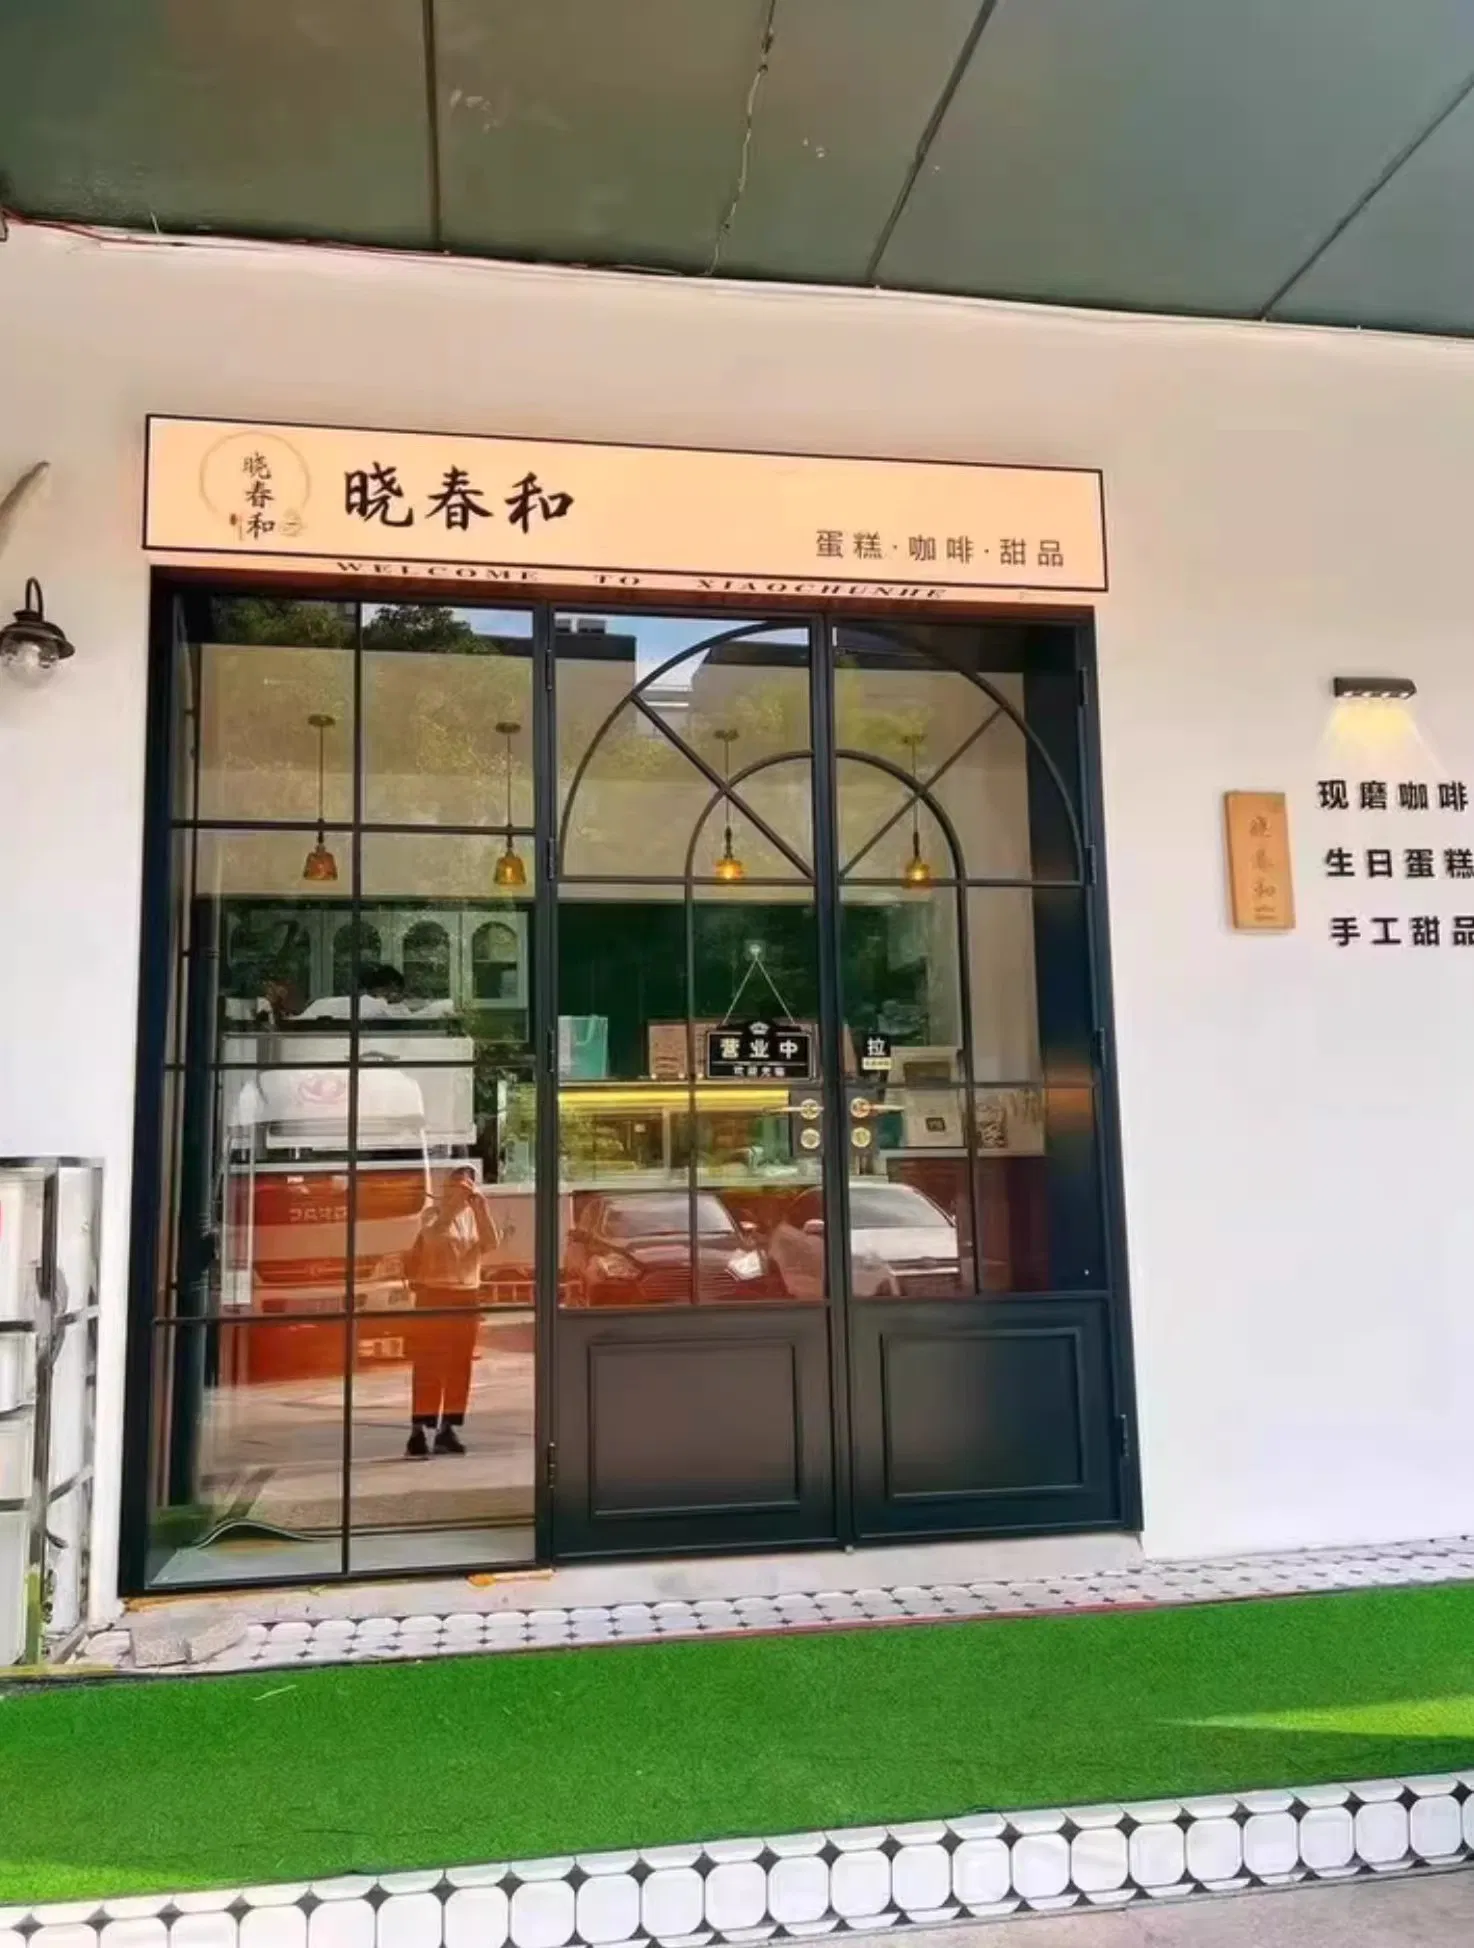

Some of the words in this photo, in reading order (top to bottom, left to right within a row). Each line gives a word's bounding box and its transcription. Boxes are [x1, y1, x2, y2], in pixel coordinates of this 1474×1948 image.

[243, 451, 276, 540] 晓春和
[343, 461, 575, 534] 晓春和
[336, 561, 538, 581] WELCOME
[593, 573, 642, 587] TO
[697, 579, 948, 599] XIAOCHUNHE
[1317, 780, 1469, 812] 现磨咖啡
[1325, 847, 1474, 880] 生日蛋糕
[1330, 916, 1474, 948] 手工甜品
[719, 1037, 799, 1060] 营业中
[864, 1035, 885, 1057] 拉
